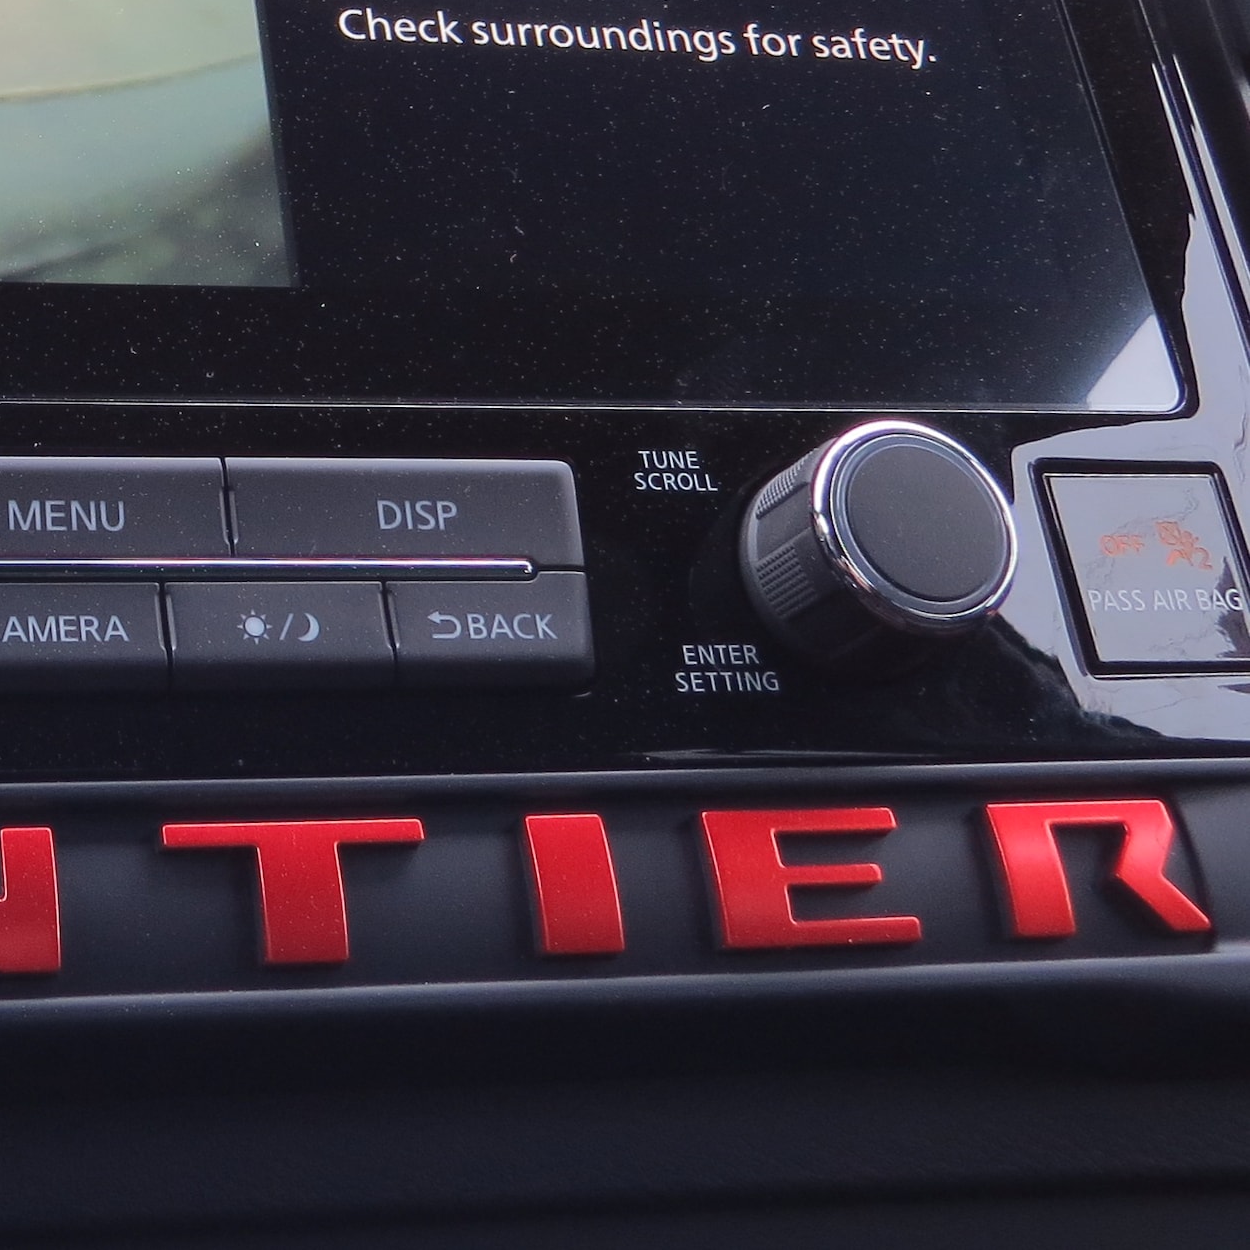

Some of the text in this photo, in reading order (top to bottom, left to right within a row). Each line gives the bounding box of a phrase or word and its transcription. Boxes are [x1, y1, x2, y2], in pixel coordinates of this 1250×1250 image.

[337, 7, 937, 69] Check surroundings for safety.
[637, 449, 701, 471] TUNE
[634, 471, 719, 493] SCROLL
[7, 499, 127, 532] MENU
[376, 499, 458, 532] DISP
[1087, 588, 1244, 612] PASS AIR BAG
[467, 613, 558, 641] BACK
[682, 644, 760, 666] ENTER
[674, 672, 780, 693] SETTING
